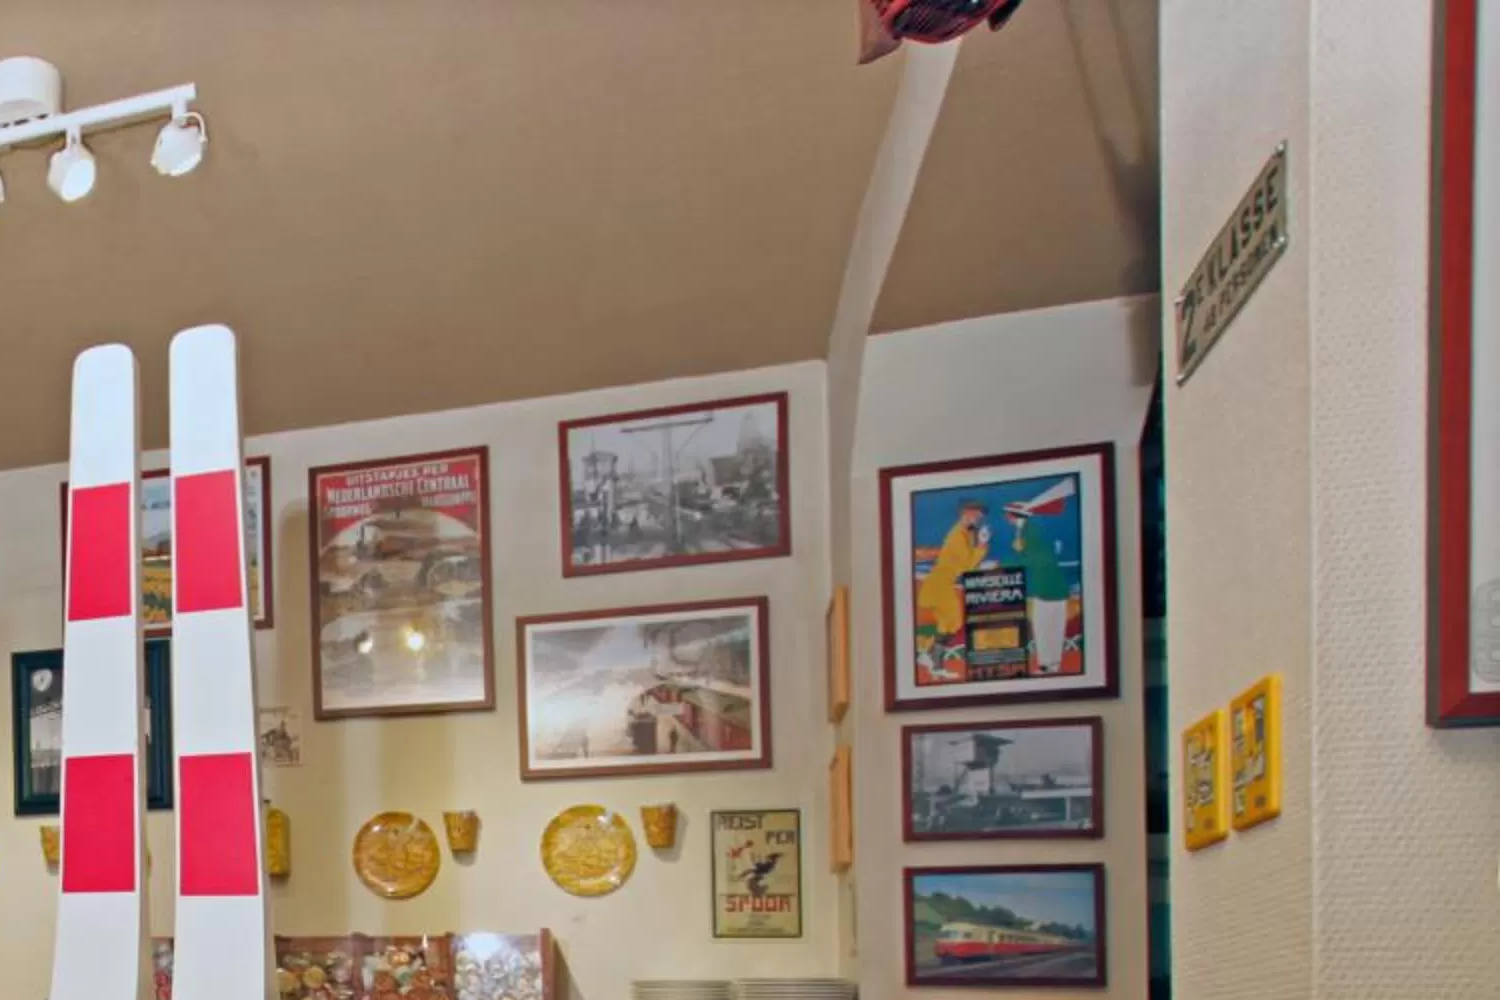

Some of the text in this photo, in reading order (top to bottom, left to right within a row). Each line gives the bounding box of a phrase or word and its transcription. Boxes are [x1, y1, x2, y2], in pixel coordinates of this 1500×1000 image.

[1207, 166, 1279, 296] KLASSE
[346, 462, 449, 486] UITSTAPJES PER
[965, 588, 1024, 605] RIVIERA
[718, 814, 763, 830] REIST
[765, 830, 795, 845] PER
[725, 894, 791, 912] SPOOR
